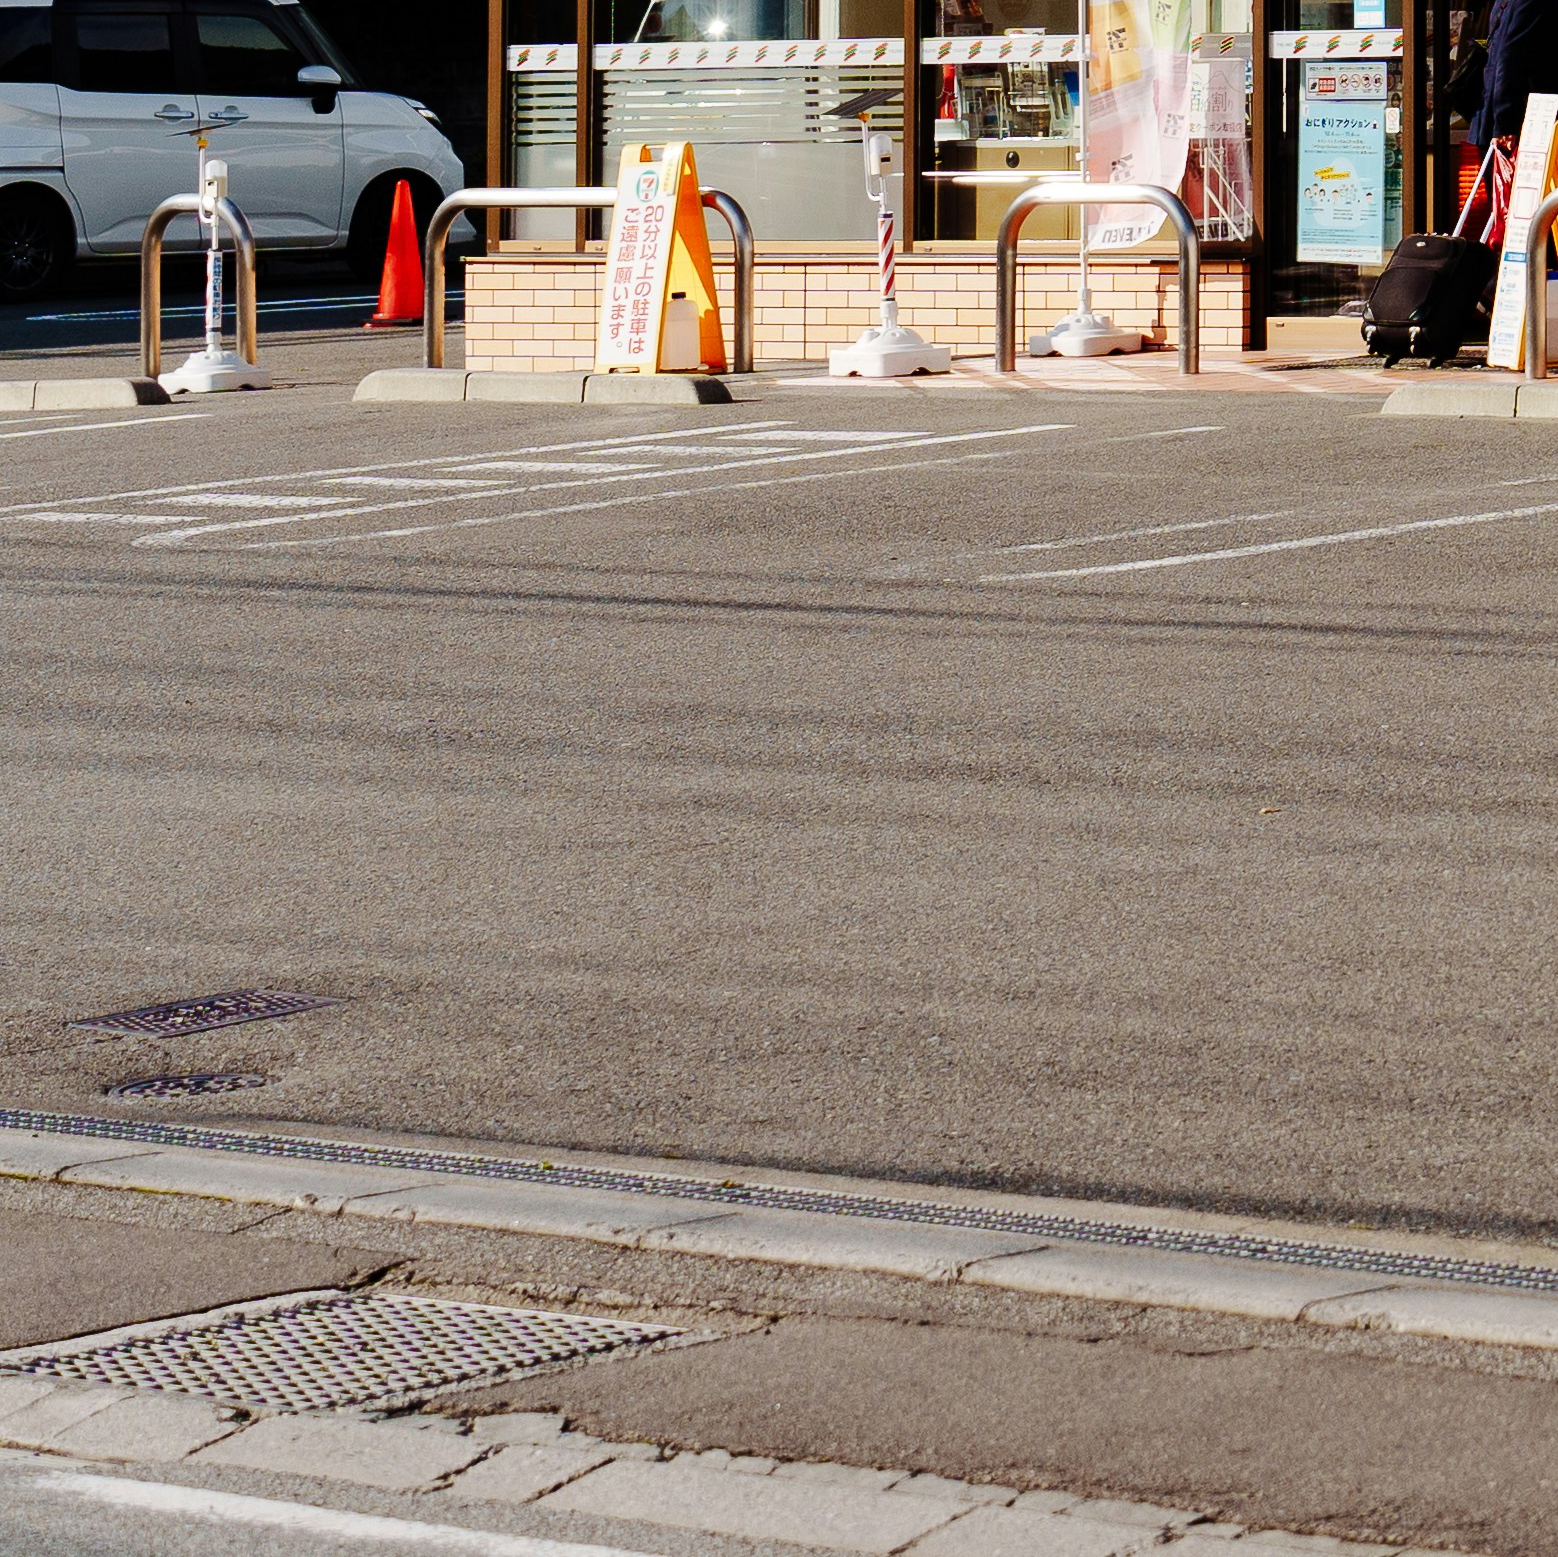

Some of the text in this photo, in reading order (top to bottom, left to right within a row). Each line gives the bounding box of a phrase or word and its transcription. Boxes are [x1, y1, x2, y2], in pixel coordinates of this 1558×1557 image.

[628, 204, 665, 355] 20分以上の駐車は
